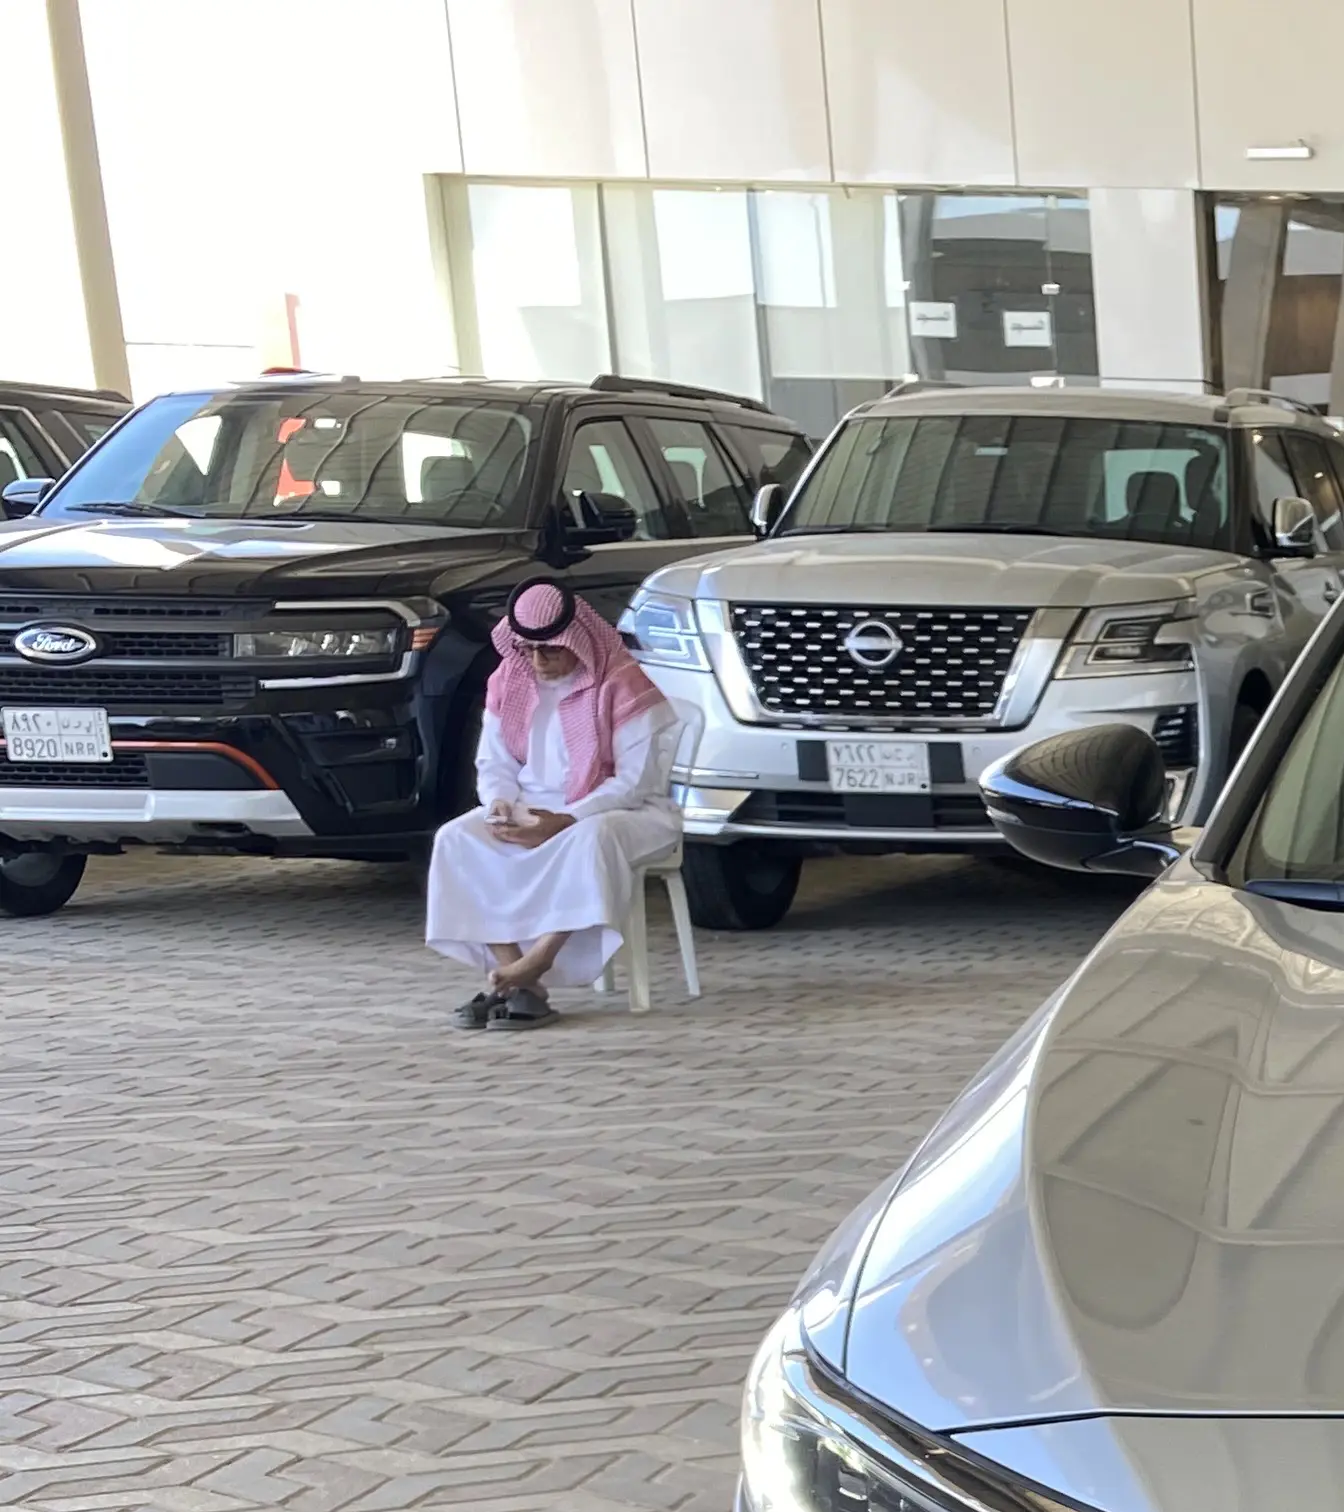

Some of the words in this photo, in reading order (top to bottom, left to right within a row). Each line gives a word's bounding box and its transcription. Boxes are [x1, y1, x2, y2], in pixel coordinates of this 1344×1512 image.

[32, 633, 77, 652] Ford
[12, 737, 58, 758] 8920
[64, 741, 96, 757] NRR
[835, 767, 880, 789] 7622
[884, 772, 917, 787] NJR
